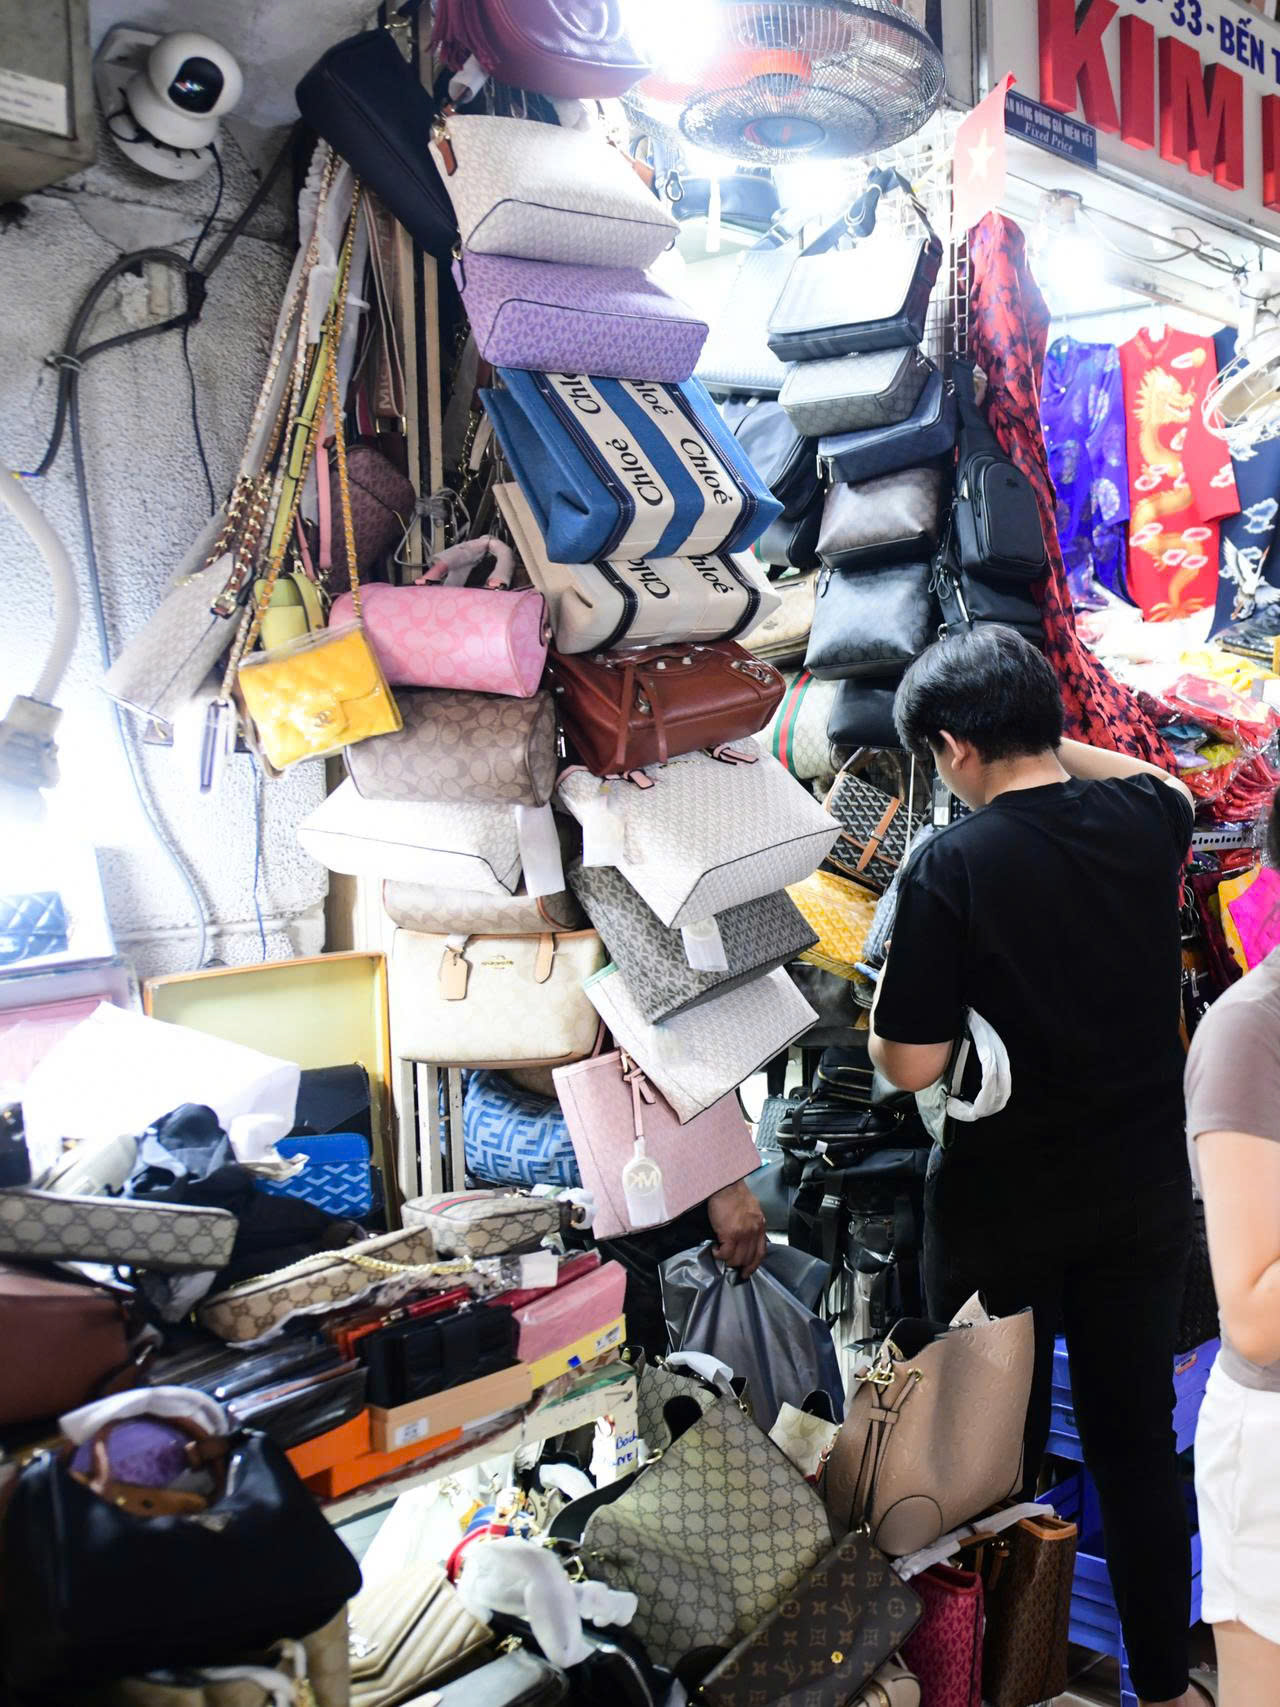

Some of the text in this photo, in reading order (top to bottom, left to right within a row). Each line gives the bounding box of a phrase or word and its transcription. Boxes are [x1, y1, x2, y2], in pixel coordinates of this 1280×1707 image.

[1219, 15, 1264, 75] BẾN
[1038, 0, 1243, 191] KIM
[1025, 121, 1073, 153] Fixed Price
[559, 373, 601, 414] Chl
[631, 381, 674, 416] hloé
[606, 438, 664, 507] Chloé
[680, 438, 733, 505] Chloé
[628, 557, 671, 599] Chlo
[688, 555, 734, 594] hloé
